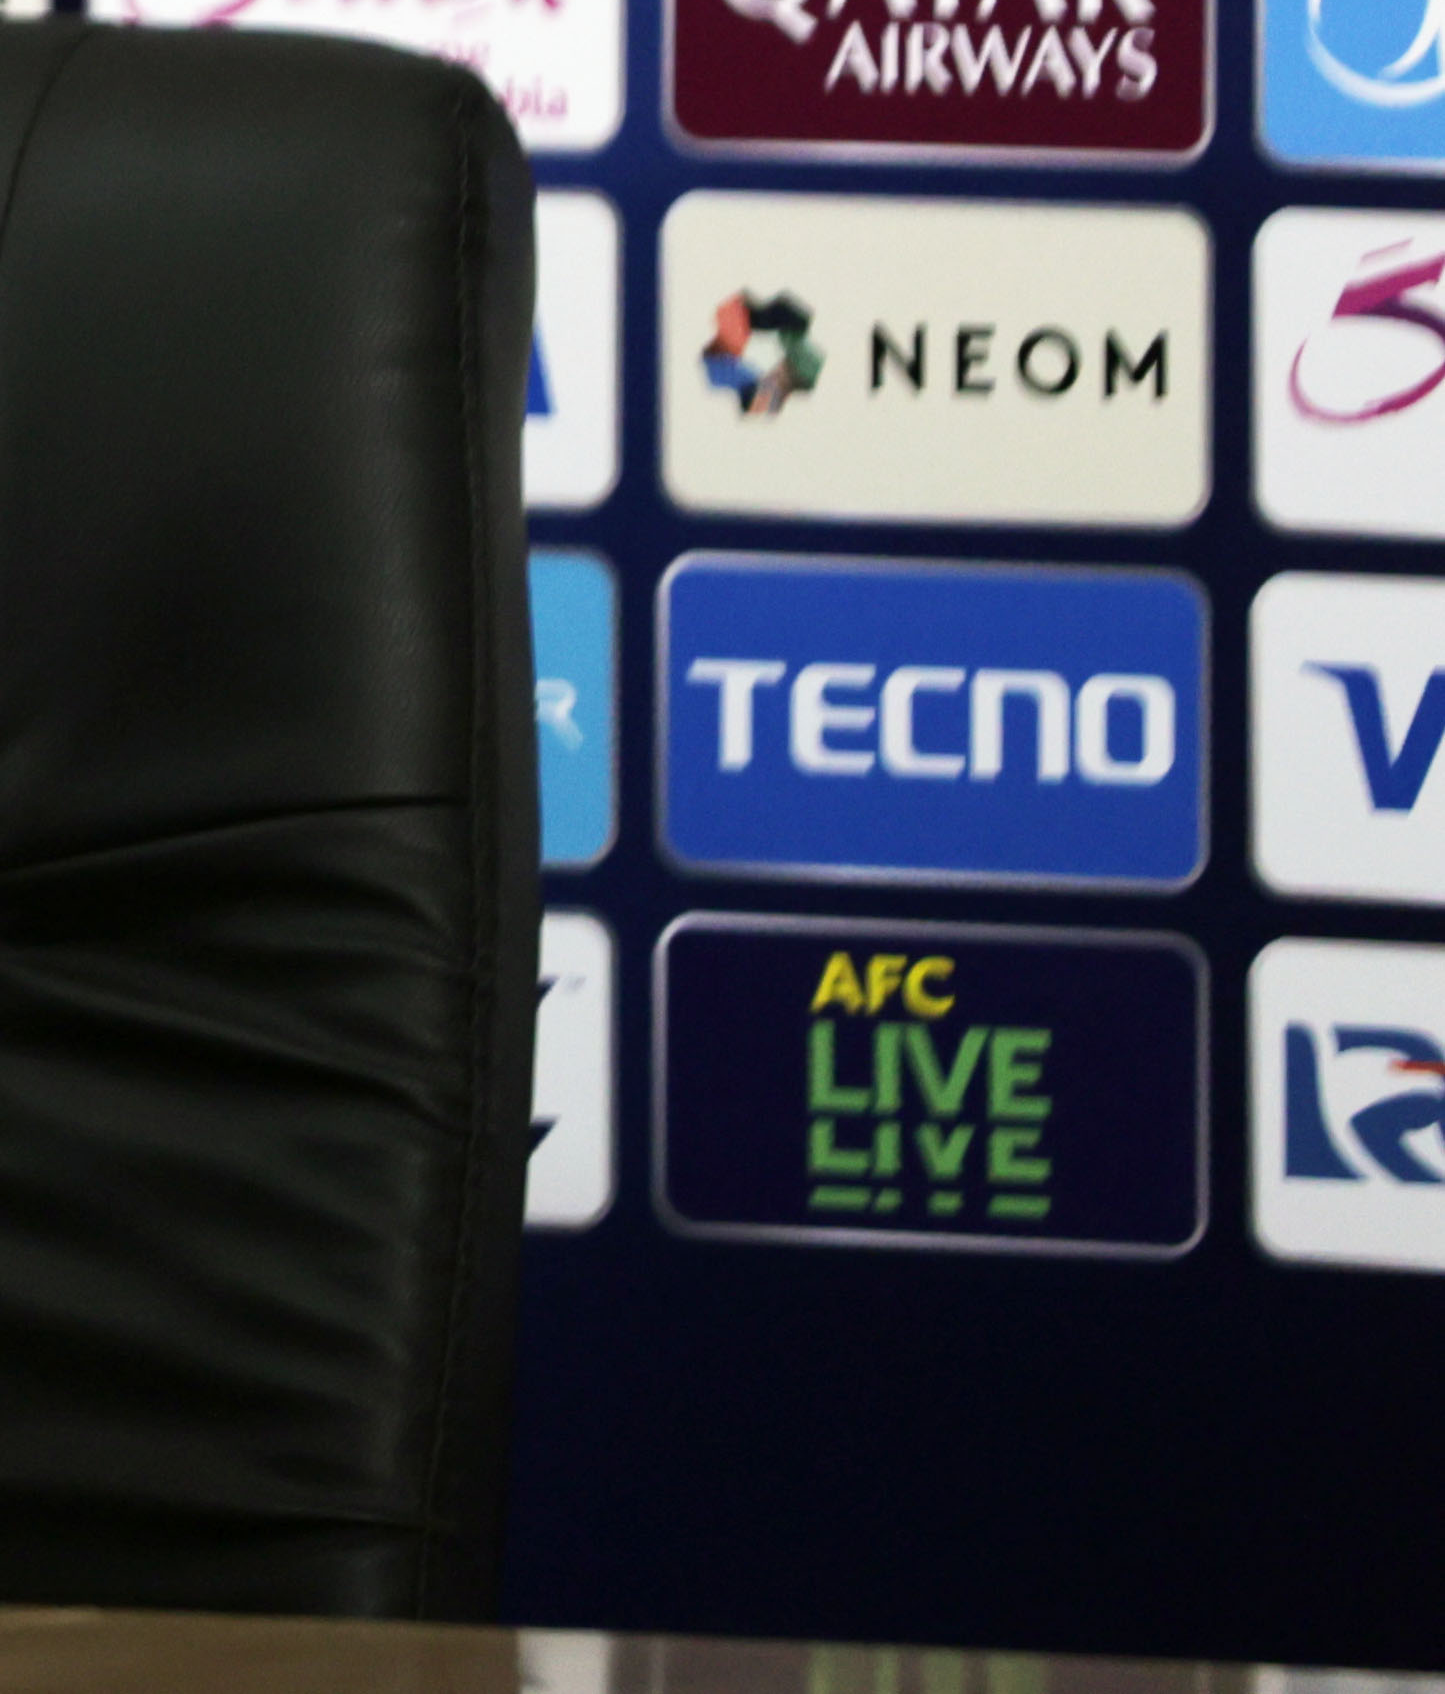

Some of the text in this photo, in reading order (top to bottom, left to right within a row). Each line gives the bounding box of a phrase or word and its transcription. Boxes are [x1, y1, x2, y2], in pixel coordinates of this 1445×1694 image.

[827, 23, 1157, 100] AIRWAYS
[870, 321, 1168, 400] NEOM
[685, 658, 1176, 786] TECNO
[809, 953, 954, 1020] AFC
[809, 1020, 1052, 1120] LIVE
